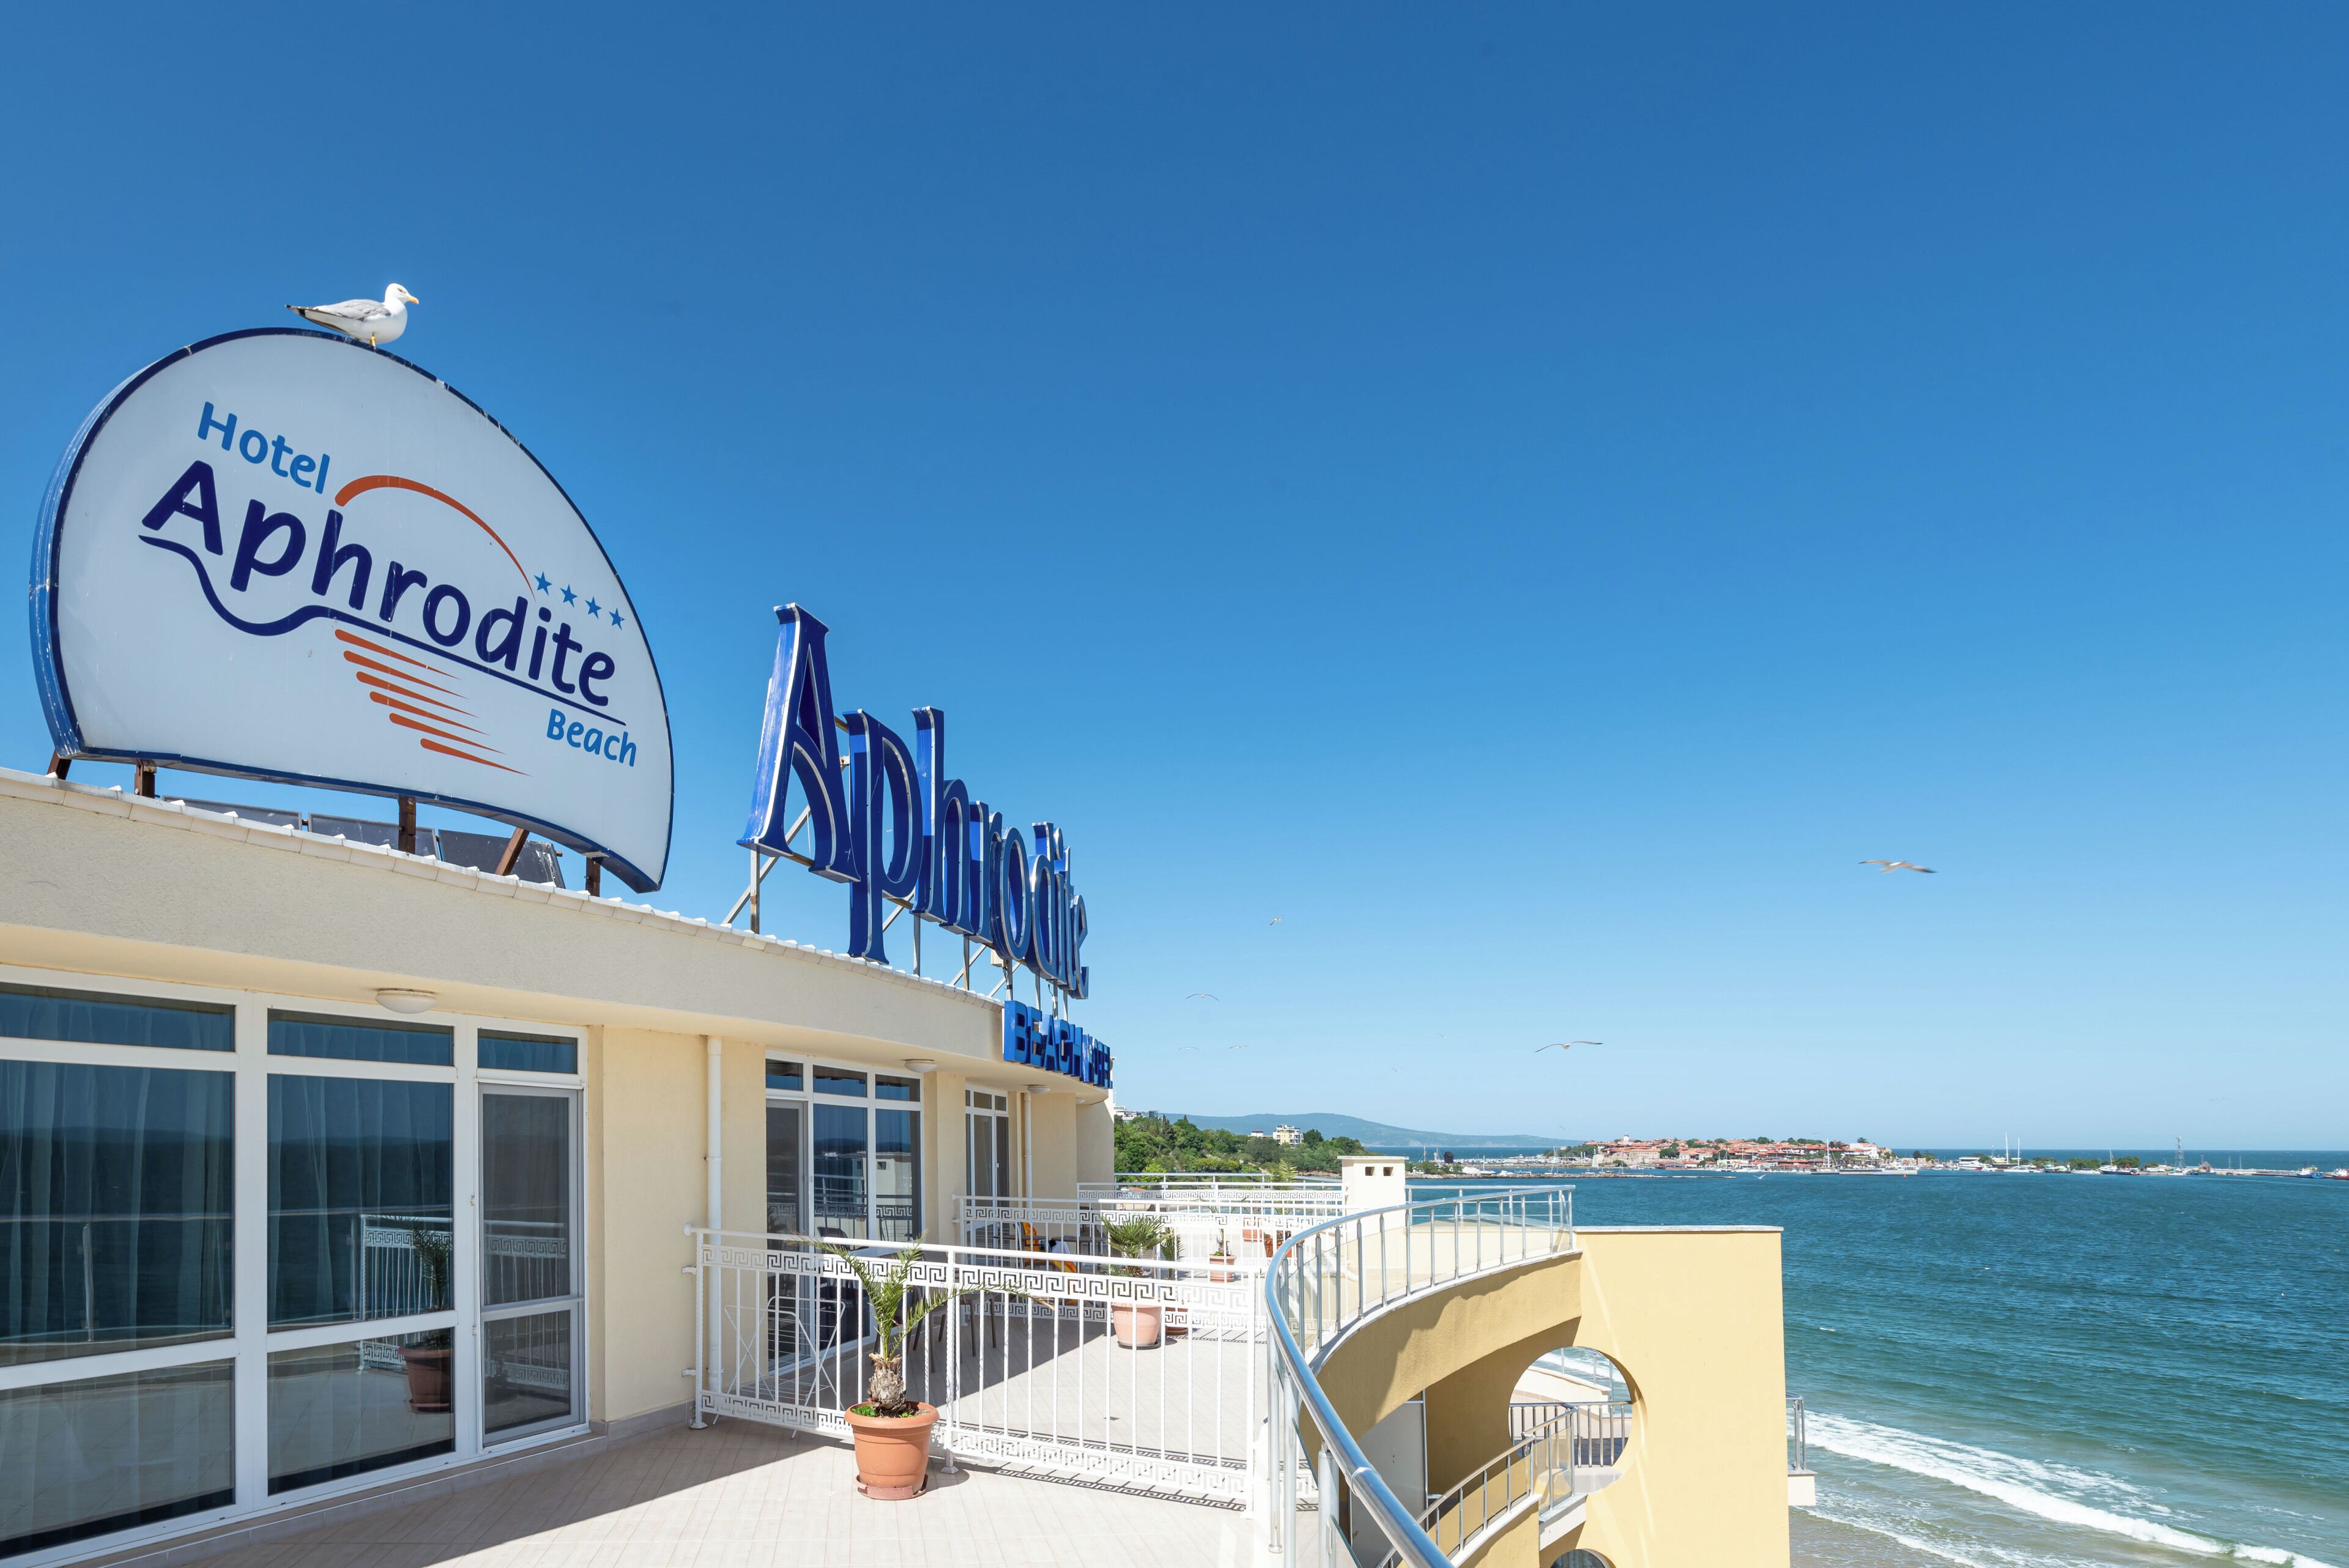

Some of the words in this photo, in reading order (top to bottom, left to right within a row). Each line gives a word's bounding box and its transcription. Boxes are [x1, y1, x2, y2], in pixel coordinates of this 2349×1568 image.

[198, 401, 330, 494] Hotel
[142, 461, 615, 706] Aphrodite
[546, 709, 636, 767] Beach
[737, 603, 1089, 1000] Aphrodite
[1004, 1000, 1083, 1082] BEACH
